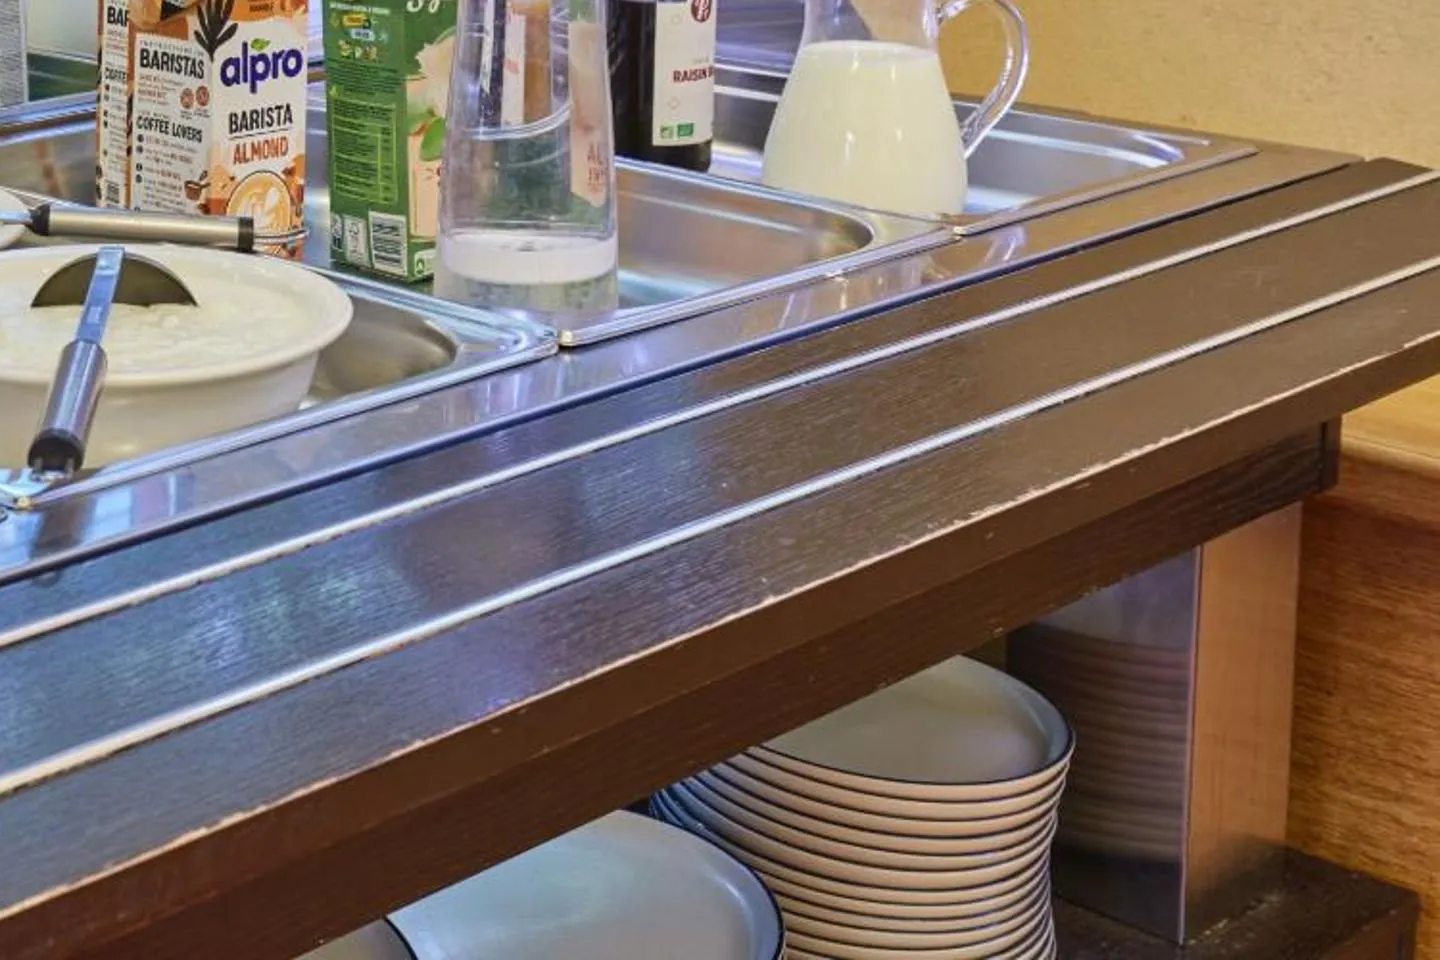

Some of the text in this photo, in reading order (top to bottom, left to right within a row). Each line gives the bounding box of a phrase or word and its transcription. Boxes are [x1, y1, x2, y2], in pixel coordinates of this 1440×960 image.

[140, 48, 204, 79] BARISTAS
[220, 41, 303, 94] alpro
[136, 115, 169, 135] COFFEE
[172, 121, 203, 143] LOVERS
[229, 103, 293, 134] BARISTA
[233, 135, 289, 164] ALMOND
